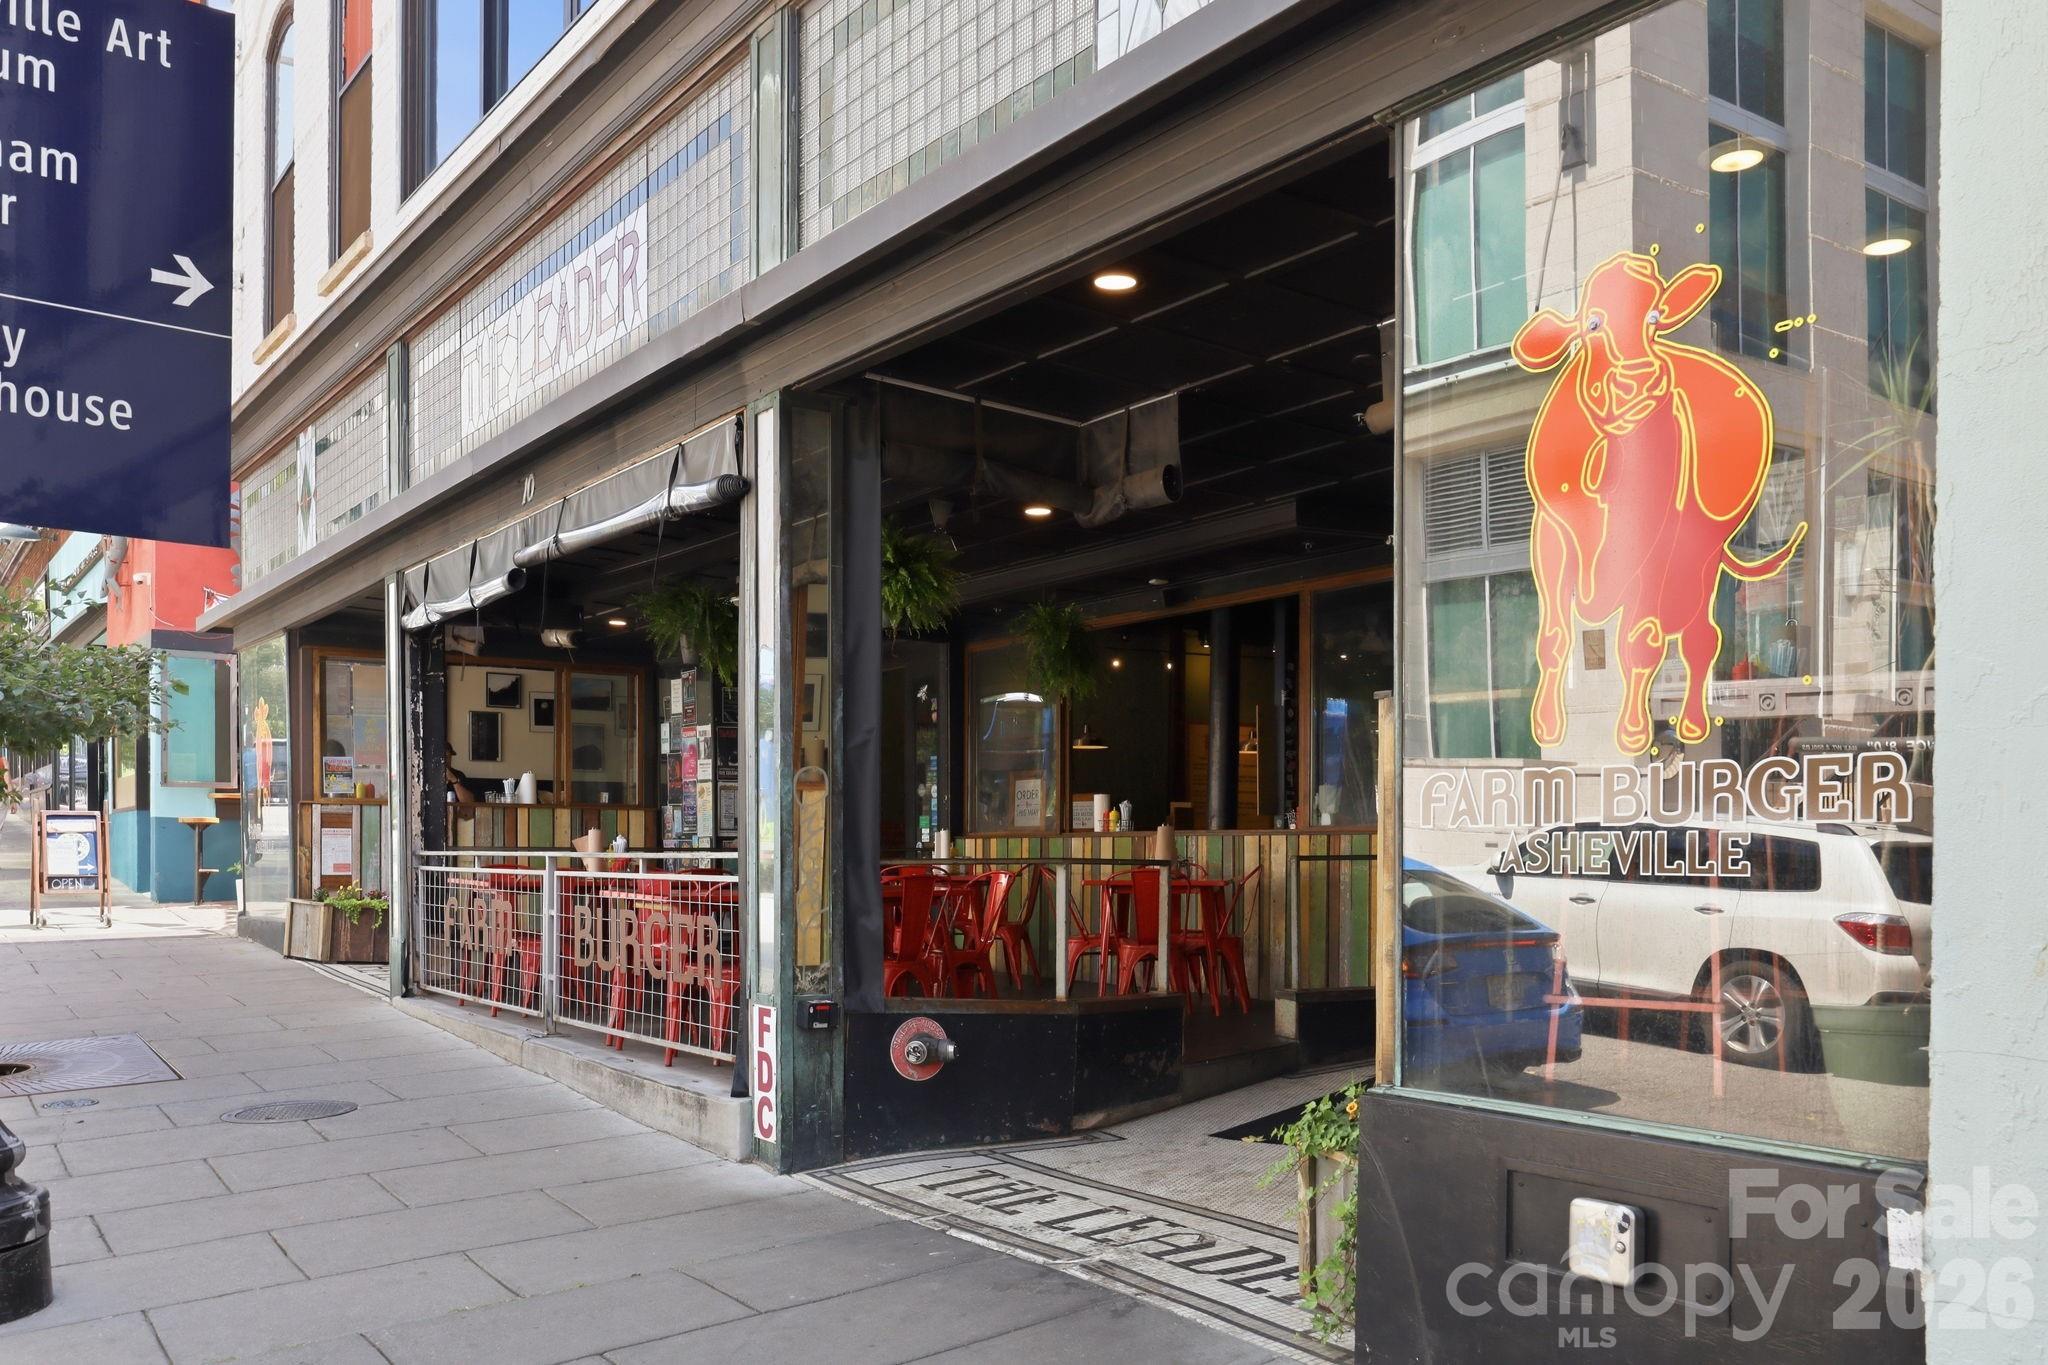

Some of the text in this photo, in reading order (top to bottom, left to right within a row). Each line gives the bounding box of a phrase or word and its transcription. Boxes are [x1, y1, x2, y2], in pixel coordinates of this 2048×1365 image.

[0, 0, 171, 69] ille Art
[0, 139, 78, 184] am
[515, 230, 640, 388] LEADER
[2, 324, 26, 368] y
[0, 370, 133, 431] house
[521, 473, 535, 506] 10
[1016, 789, 1040, 801] ORDER
[1420, 751, 1915, 829] FARM BURGER
[51, 877, 83, 891] OPEN
[1500, 831, 1752, 878] ASHEVILLE
[444, 896, 723, 989] FARM BURGER
[757, 1007, 774, 1138] FDC
[918, 1169, 1301, 1305] THE LEADE
